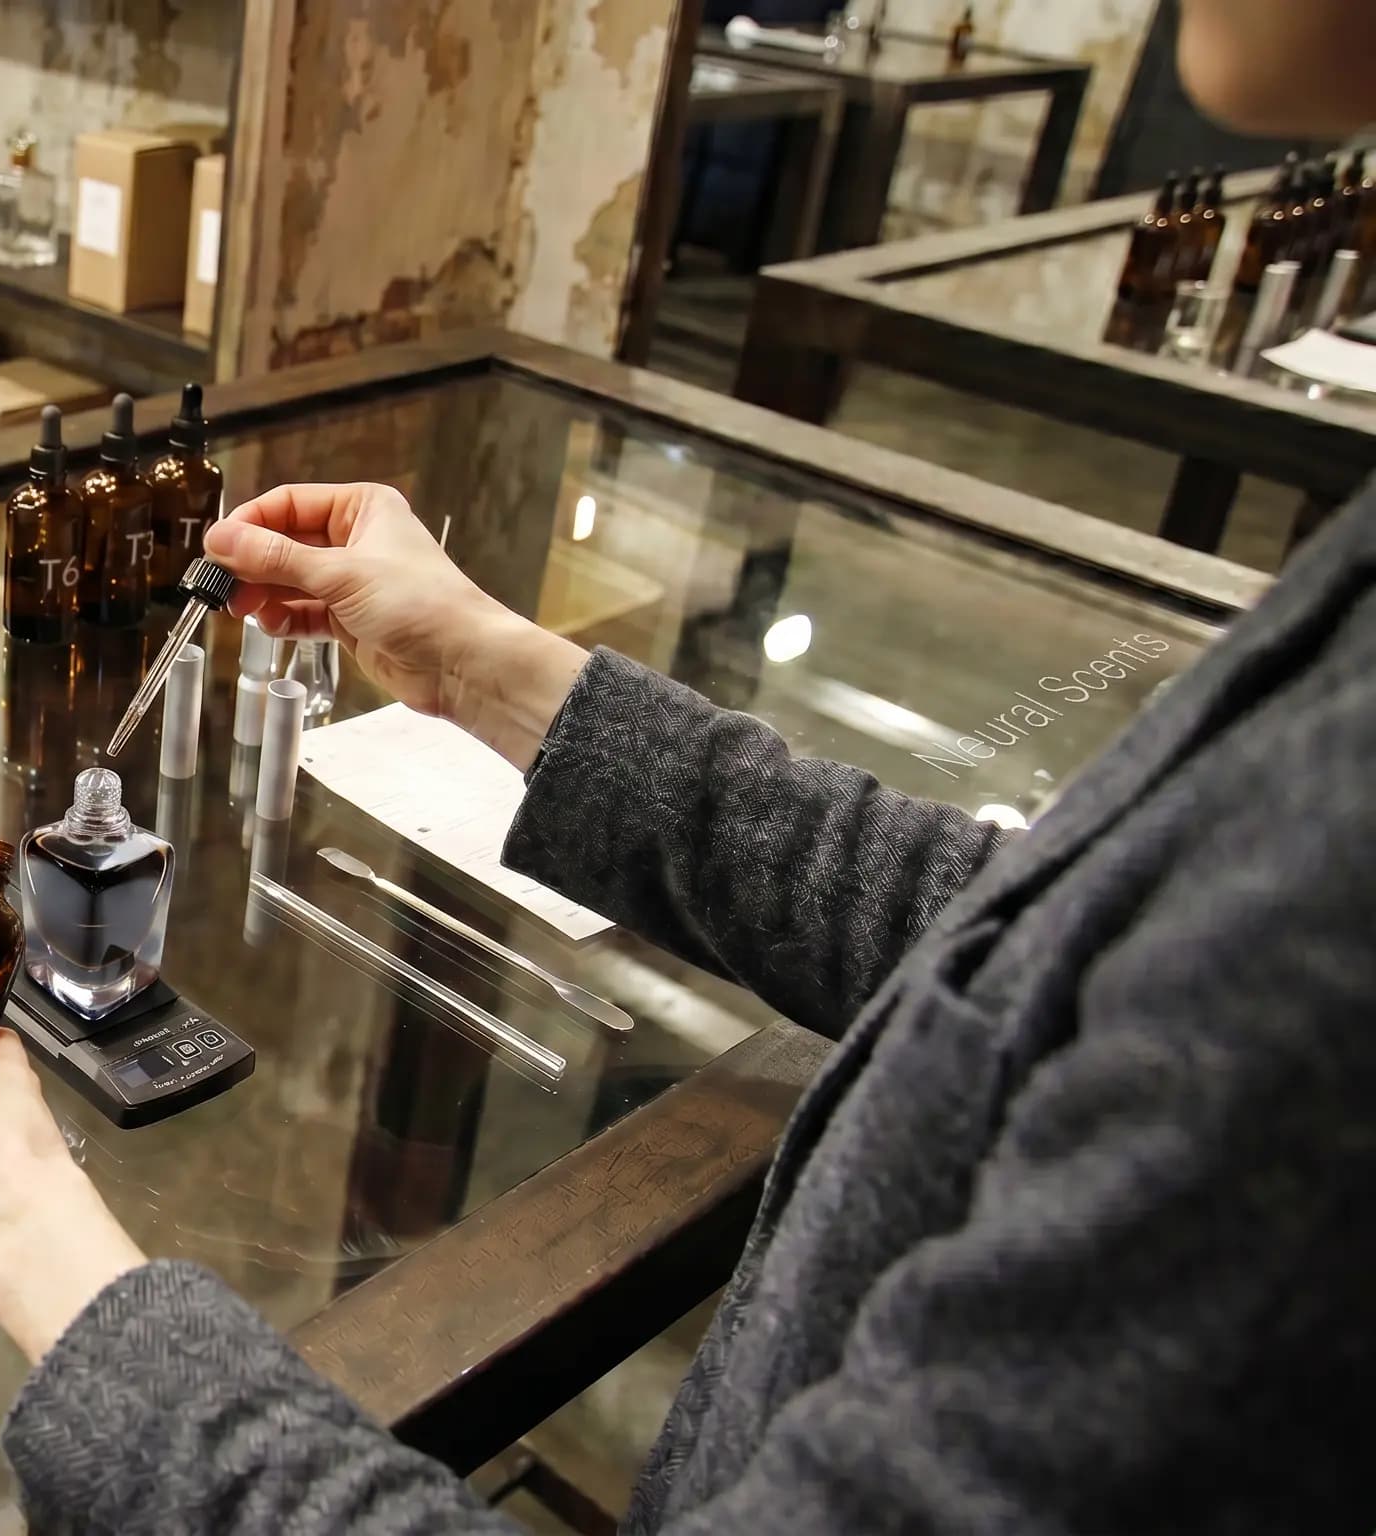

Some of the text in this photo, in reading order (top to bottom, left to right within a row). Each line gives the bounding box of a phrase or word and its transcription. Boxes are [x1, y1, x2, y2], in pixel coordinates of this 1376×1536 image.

[125, 530, 154, 566] T3
[179, 518, 213, 549] T
[39, 556, 79, 591] T6
[910, 633, 1170, 779] Neural Scents
